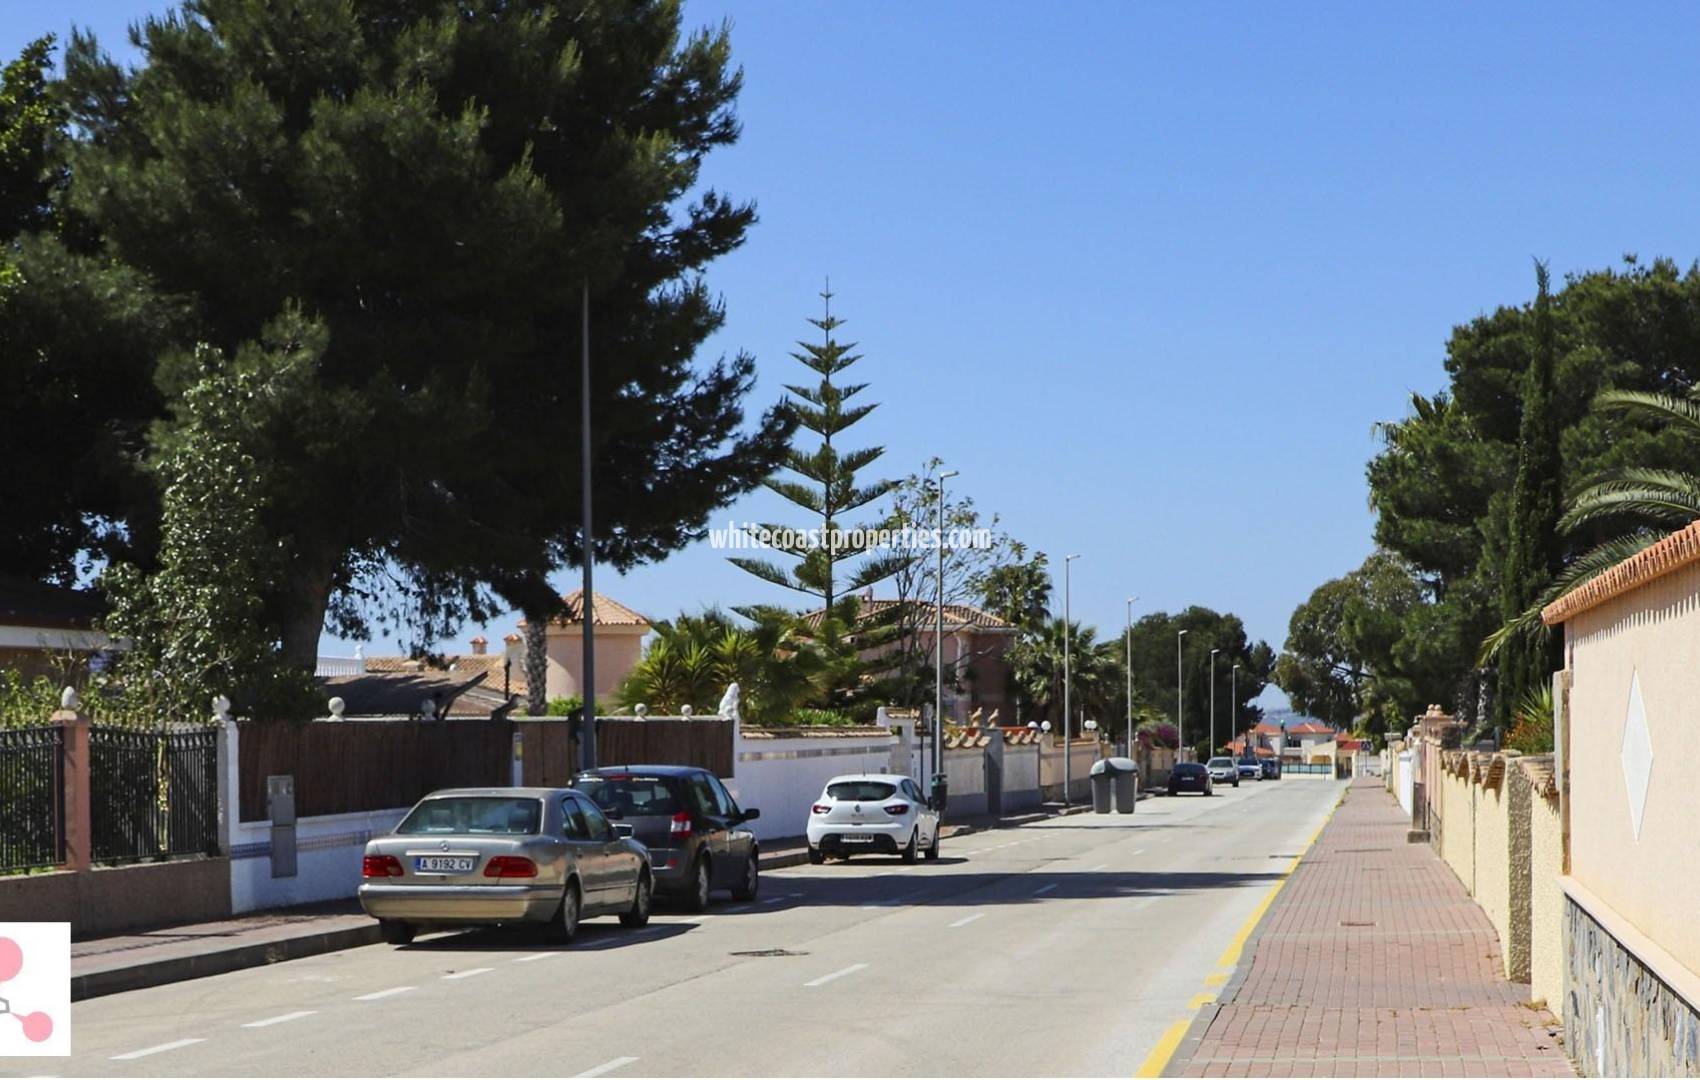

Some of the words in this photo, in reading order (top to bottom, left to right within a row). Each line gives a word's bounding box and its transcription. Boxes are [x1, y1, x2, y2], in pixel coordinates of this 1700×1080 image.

[422, 859, 428, 869] A
[431, 858, 456, 870] 9192
[459, 859, 472, 869] CV
